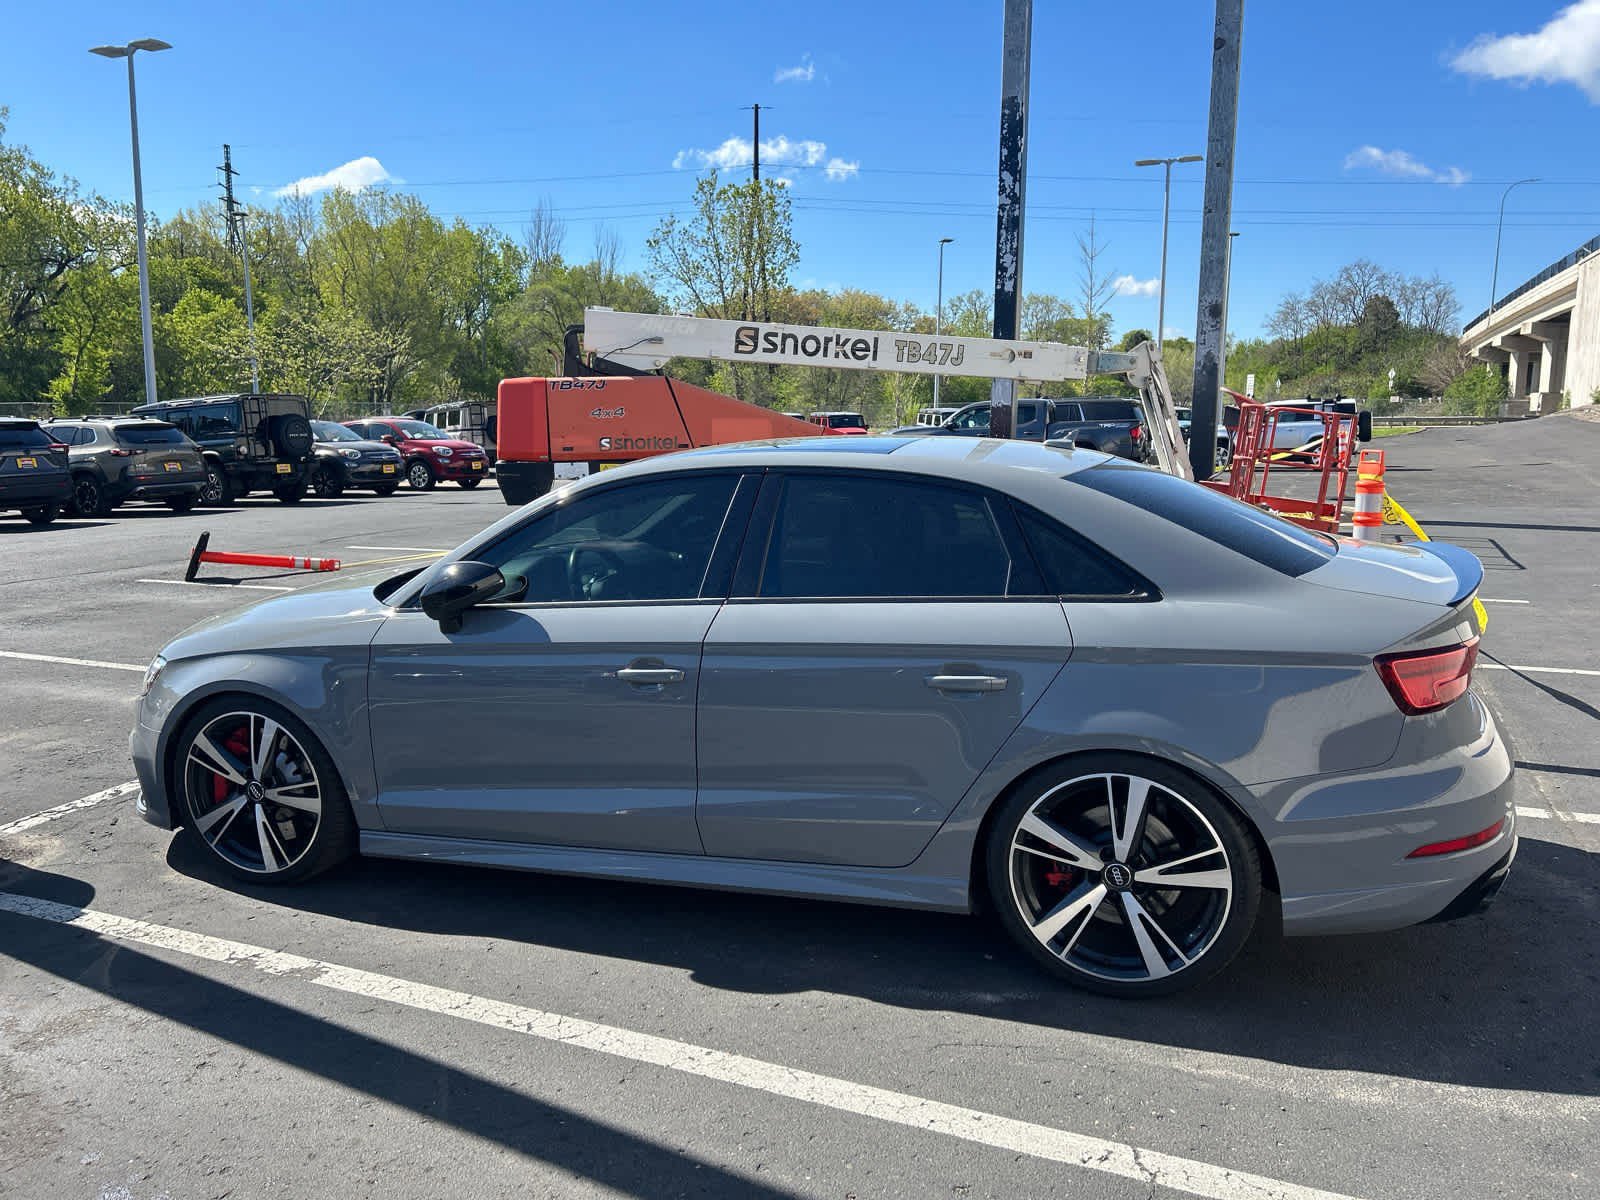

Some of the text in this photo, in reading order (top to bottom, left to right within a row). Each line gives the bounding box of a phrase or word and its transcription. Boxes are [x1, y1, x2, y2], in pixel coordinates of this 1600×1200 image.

[761, 330, 879, 362] snorkel
[894, 339, 965, 367] TB47J
[549, 379, 606, 390] TB47J
[591, 407, 625, 418] 4x4
[613, 435, 678, 450] snorkel
